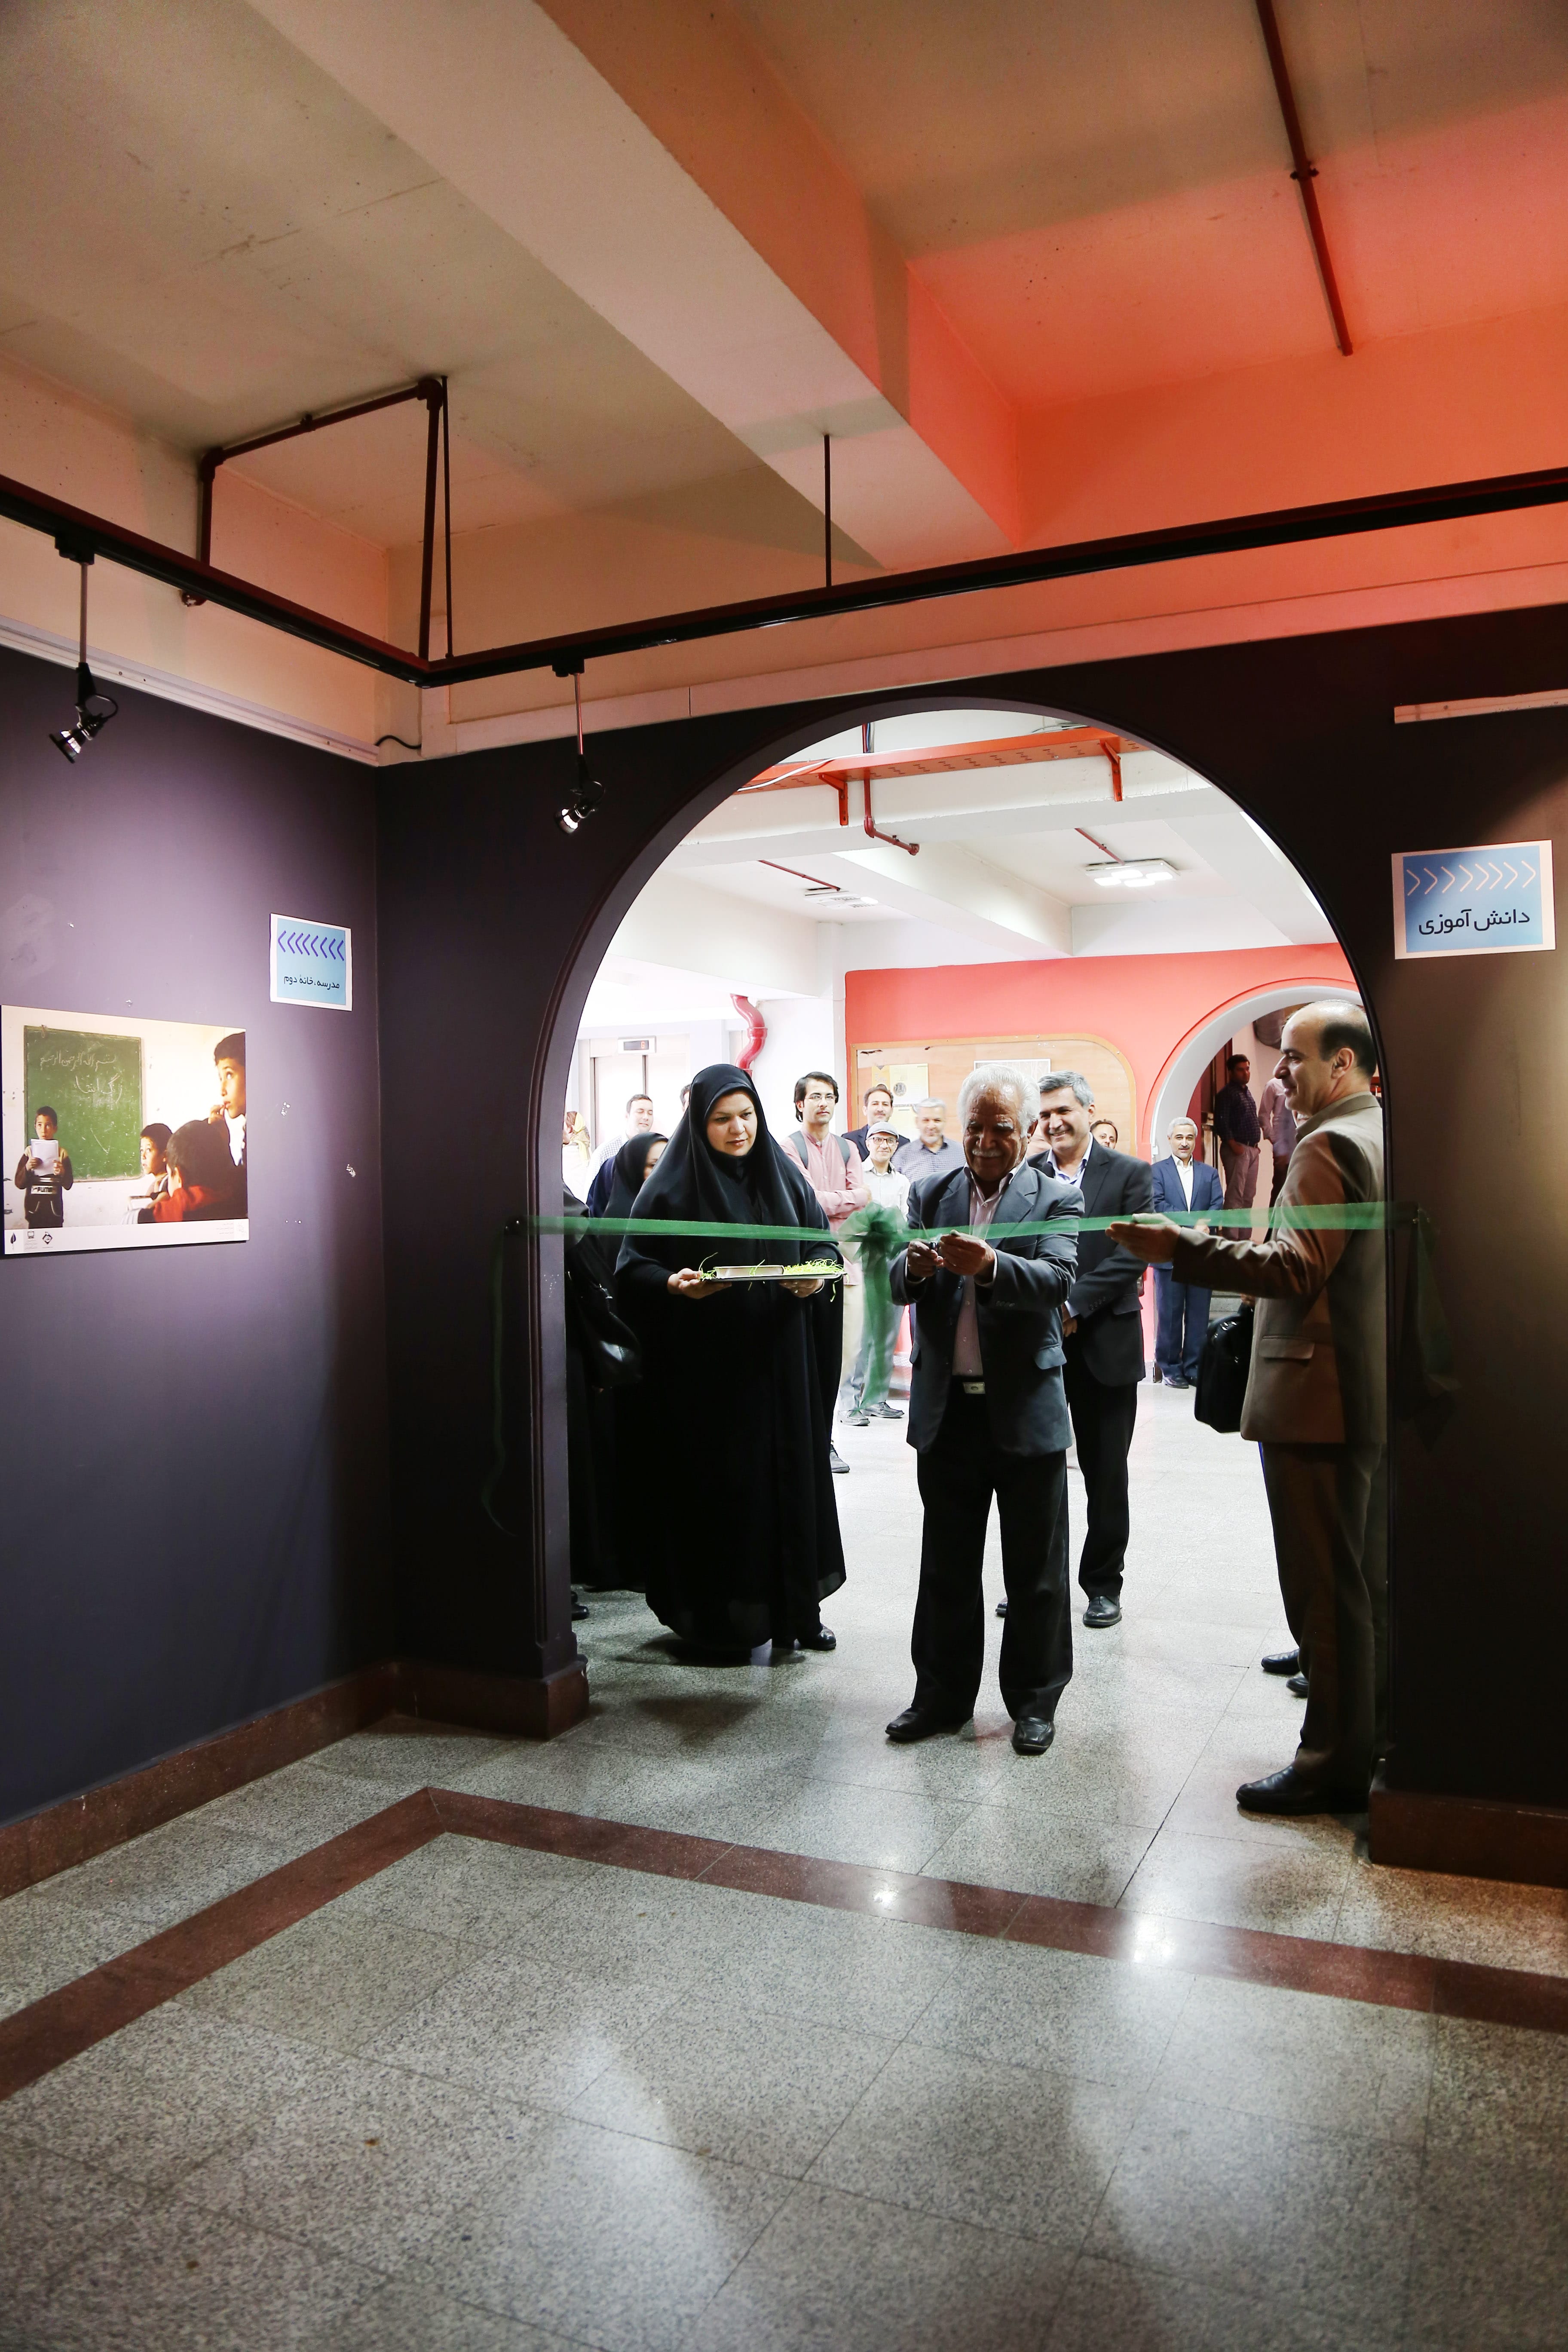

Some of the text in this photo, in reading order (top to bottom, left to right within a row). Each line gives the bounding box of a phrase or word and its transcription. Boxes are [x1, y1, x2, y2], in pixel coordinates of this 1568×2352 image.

[1418, 909, 1530, 935] دانش آموزی
[284, 976, 297, 985] دوم
